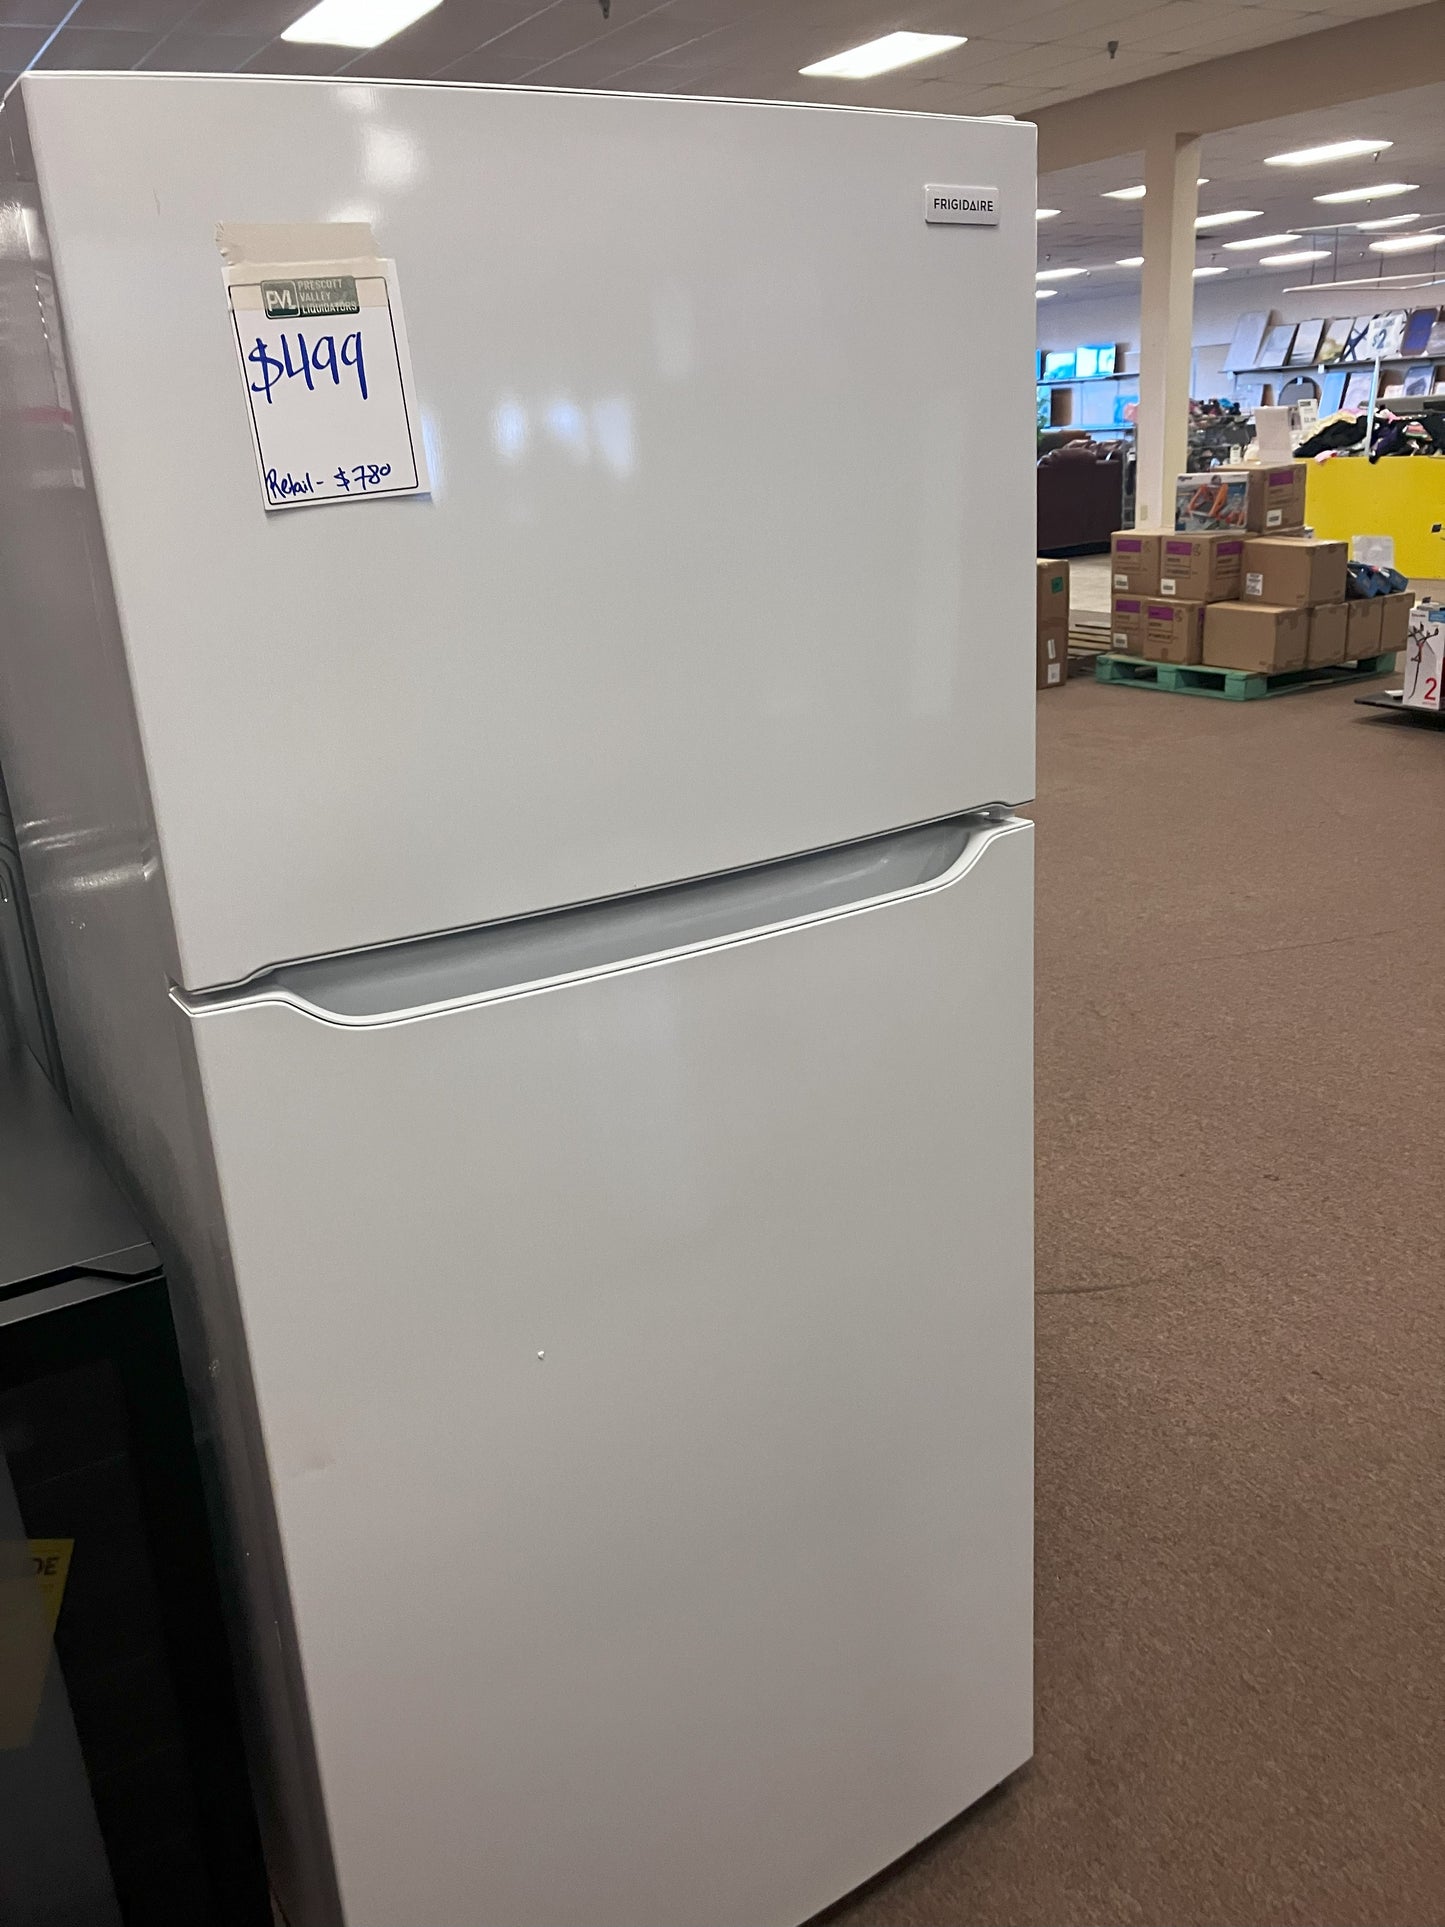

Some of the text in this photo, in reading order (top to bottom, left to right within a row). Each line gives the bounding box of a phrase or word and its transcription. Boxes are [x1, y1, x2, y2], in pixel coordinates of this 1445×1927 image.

[933, 198, 994, 212] FRIGIDAIRE
[297, 279, 343, 291] PRESCOTT
[265, 289, 297, 312] PVL
[299, 291, 331, 302] VALLEY
[300, 301, 358, 314] LIQUIDATORS
[248, 331, 368, 404] $499
[333, 463, 392, 492] $780
[1423, 677, 1438, 701] 2
